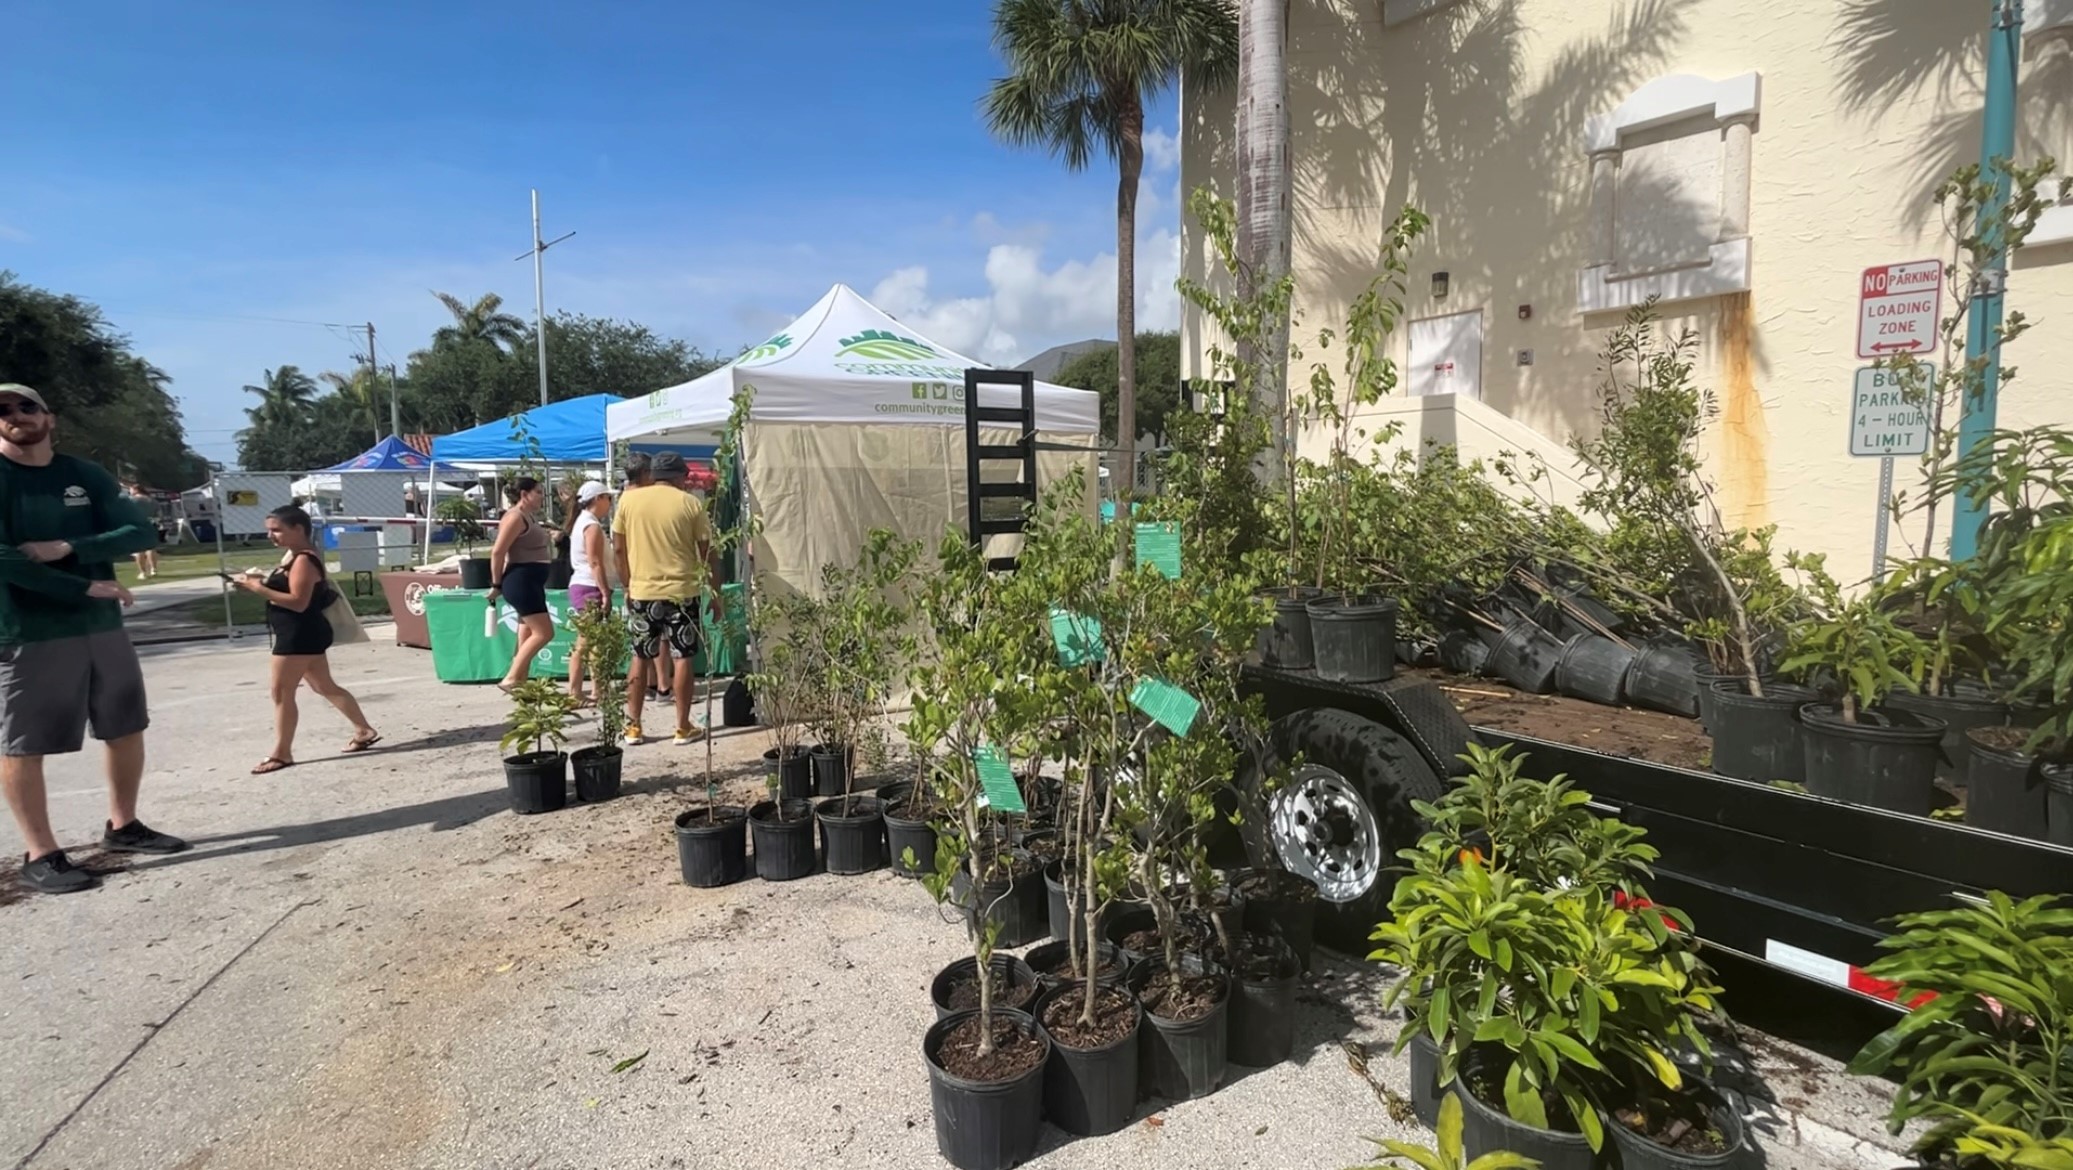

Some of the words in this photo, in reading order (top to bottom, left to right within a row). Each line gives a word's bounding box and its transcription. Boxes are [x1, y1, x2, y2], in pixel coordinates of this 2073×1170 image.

[1864, 273, 1887, 293] NO
[1888, 269, 1938, 288] PARKING
[1868, 300, 1932, 318] LOADING
[1878, 320, 1917, 335] ZONE
[1873, 372, 1913, 388] BU
[1858, 389, 1926, 407] PARK
[1864, 432, 1914, 447] LIMIT
